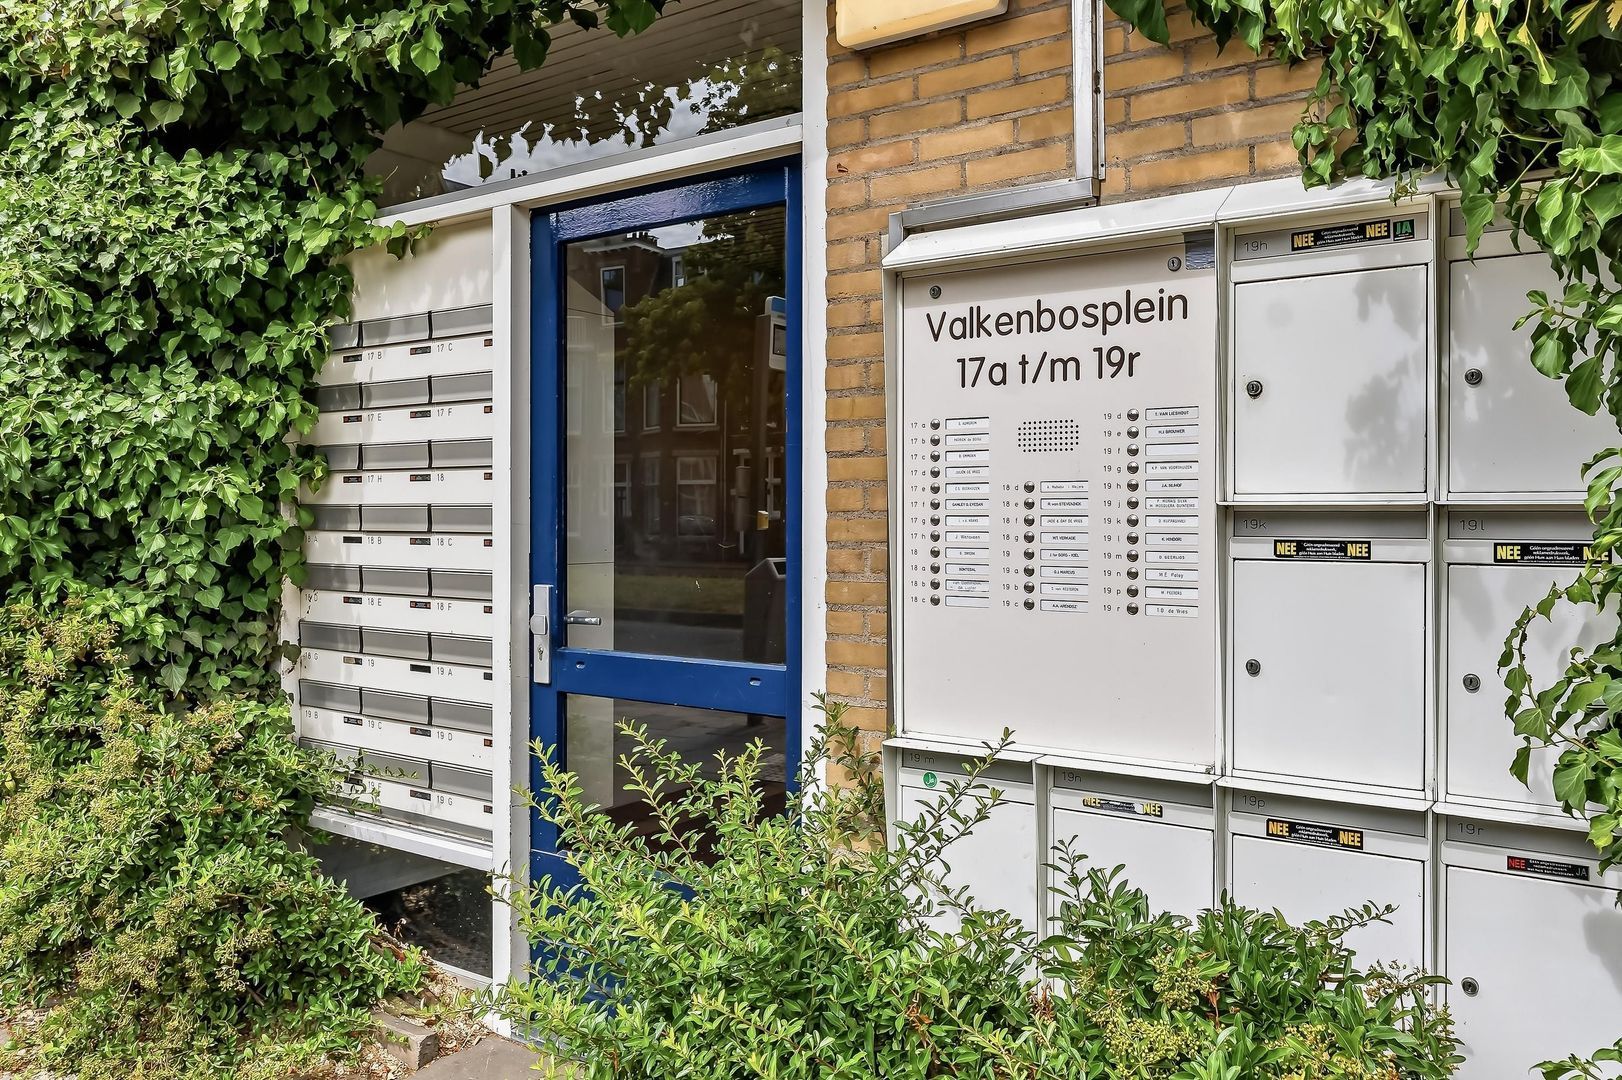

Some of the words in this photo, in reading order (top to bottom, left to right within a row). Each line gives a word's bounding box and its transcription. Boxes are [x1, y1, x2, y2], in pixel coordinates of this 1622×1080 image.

[1365, 222, 1388, 238] NEE
[1396, 221, 1412, 235] JA
[1294, 232, 1314, 248] NEE
[1244, 240, 1268, 252] 19h
[926, 288, 1188, 342] Valkenbosplein
[437, 344, 444, 352] 17
[956, 356, 1007, 388] 17a
[1018, 351, 1080, 384] t/m
[1092, 346, 1141, 380] 19r
[367, 475, 374, 483] 17
[437, 473, 444, 481] 18
[1242, 519, 1267, 530] 19k
[1276, 542, 1296, 555] NEE
[1347, 543, 1368, 556] NEE
[1497, 546, 1521, 559] NEE
[368, 659, 374, 667] 19
[437, 667, 444, 675] 19
[305, 710, 311, 718] 19
[368, 720, 374, 728] 19
[437, 731, 444, 740] 19
[910, 753, 920, 762] 19
[1062, 771, 1082, 782] 19n
[437, 796, 444, 804] 19
[1083, 797, 1100, 806] NEE
[1242, 795, 1266, 810] 19p
[1143, 803, 1160, 815] NEE
[1268, 821, 1289, 836] NEE
[1458, 822, 1484, 836] 19r
[1339, 831, 1360, 846] NEE
[1509, 859, 1525, 869] NEE
[1576, 868, 1587, 876] JA
